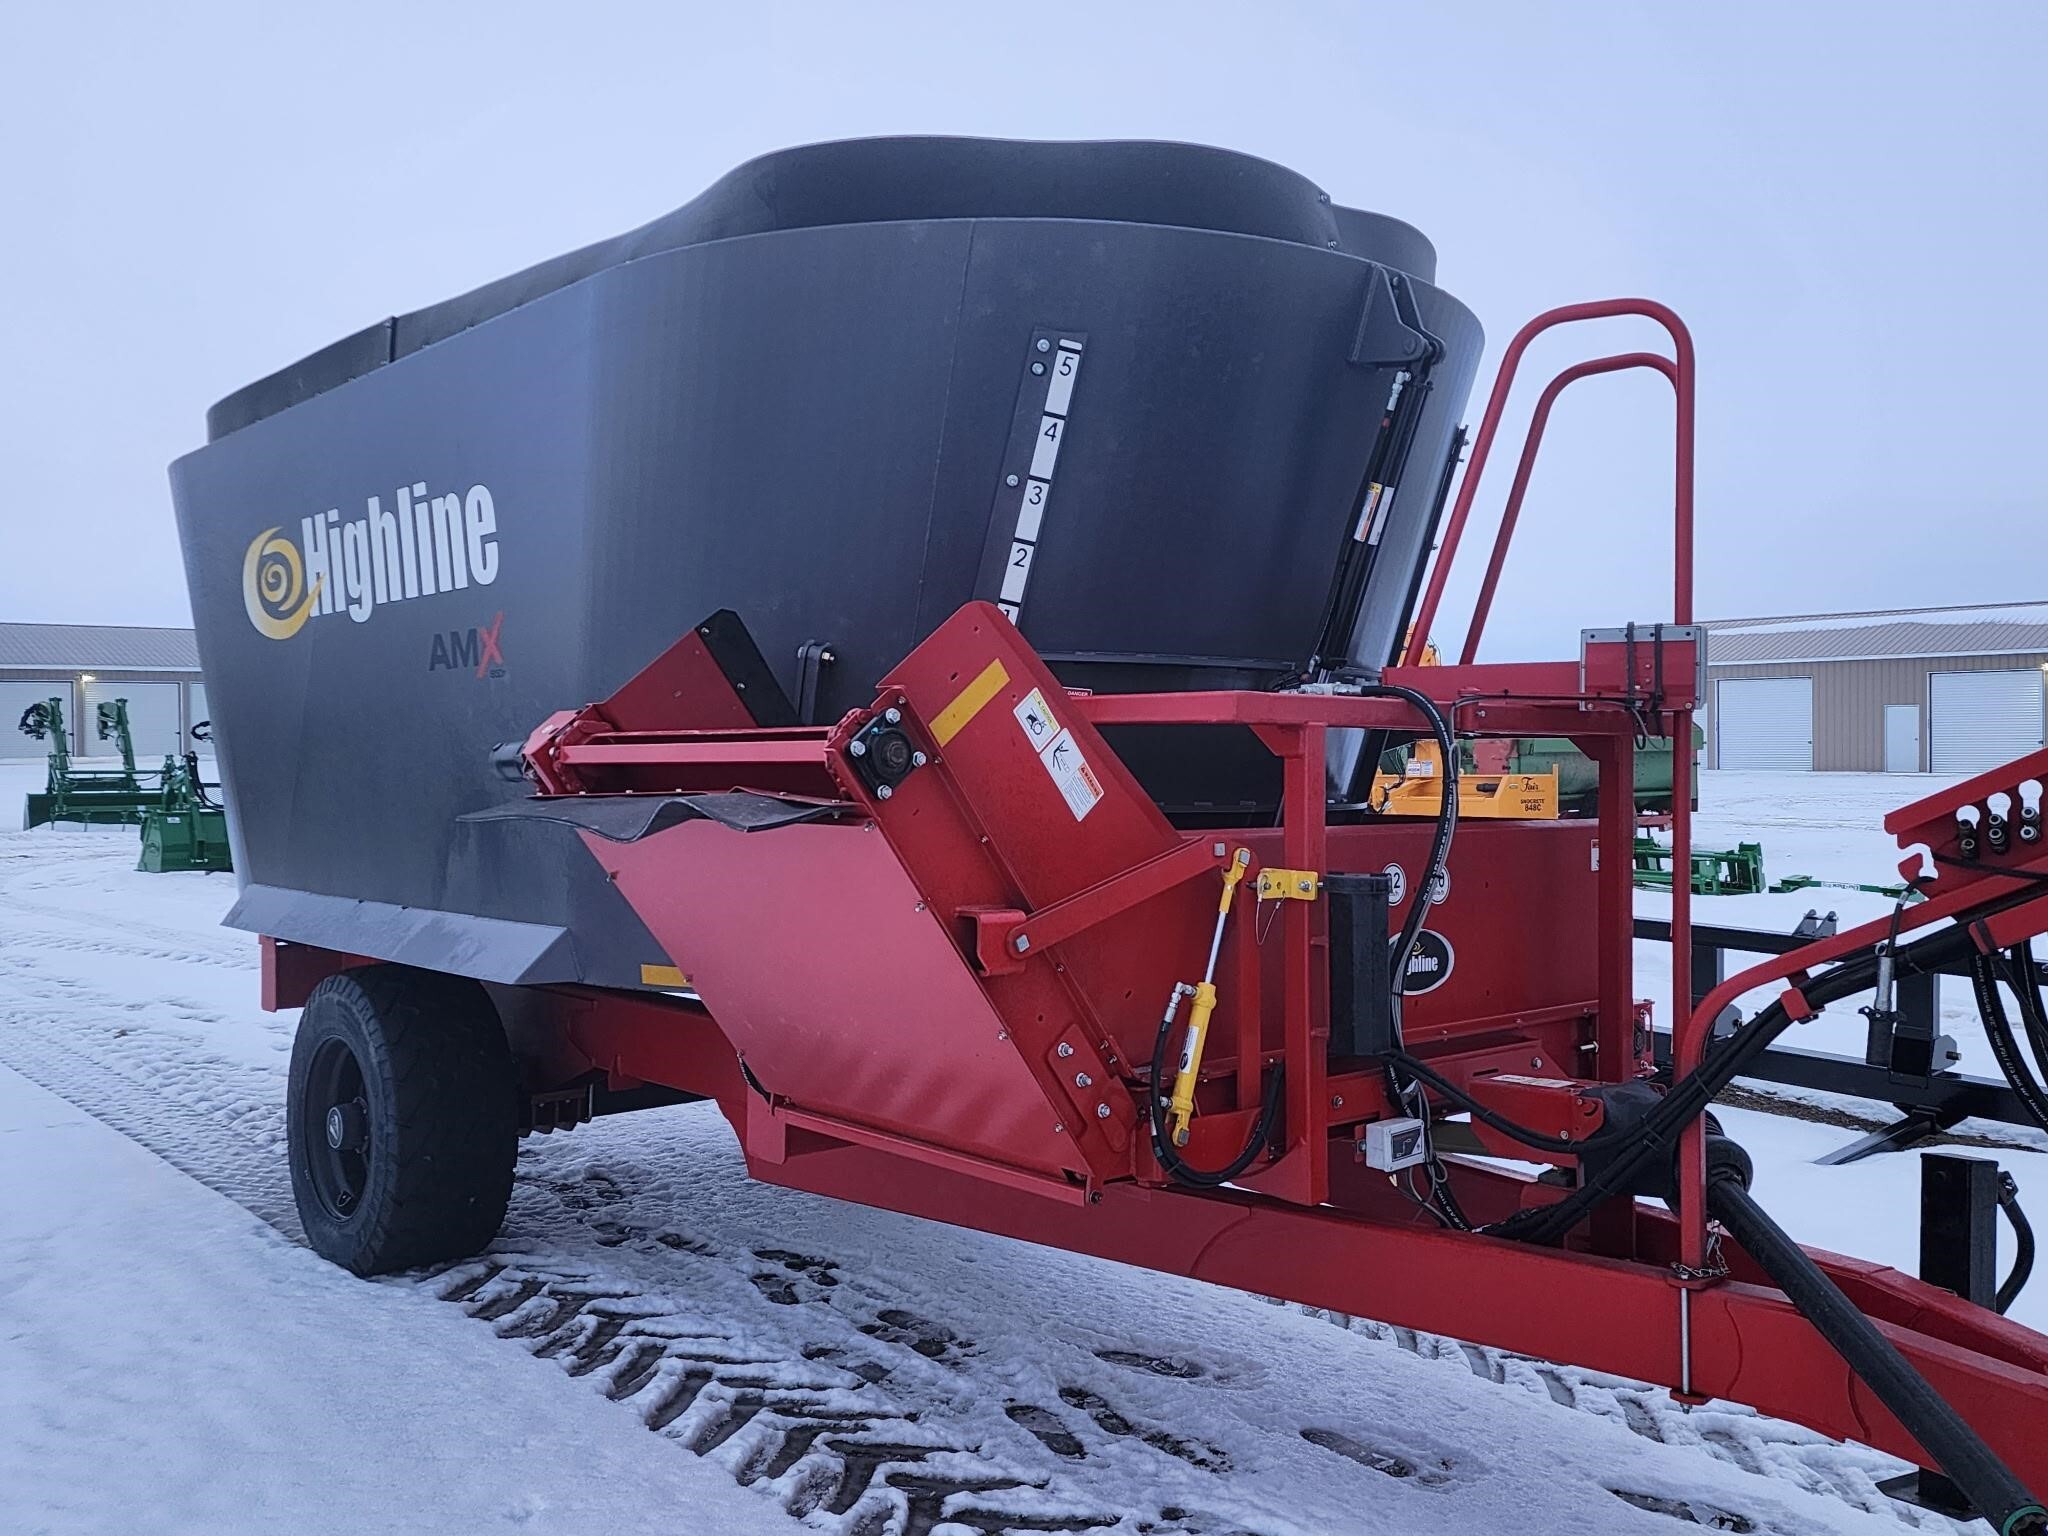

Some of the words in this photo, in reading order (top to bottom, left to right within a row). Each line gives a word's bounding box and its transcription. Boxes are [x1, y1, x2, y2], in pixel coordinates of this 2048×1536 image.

[1059, 356, 1074, 376] 5
[1044, 422, 1058, 442] 4
[1029, 485, 1043, 505] 3
[302, 481, 499, 623] Highline
[1013, 548, 1028, 567] 2
[428, 610, 505, 678] AMX
[1520, 776, 1539, 792] Fair
